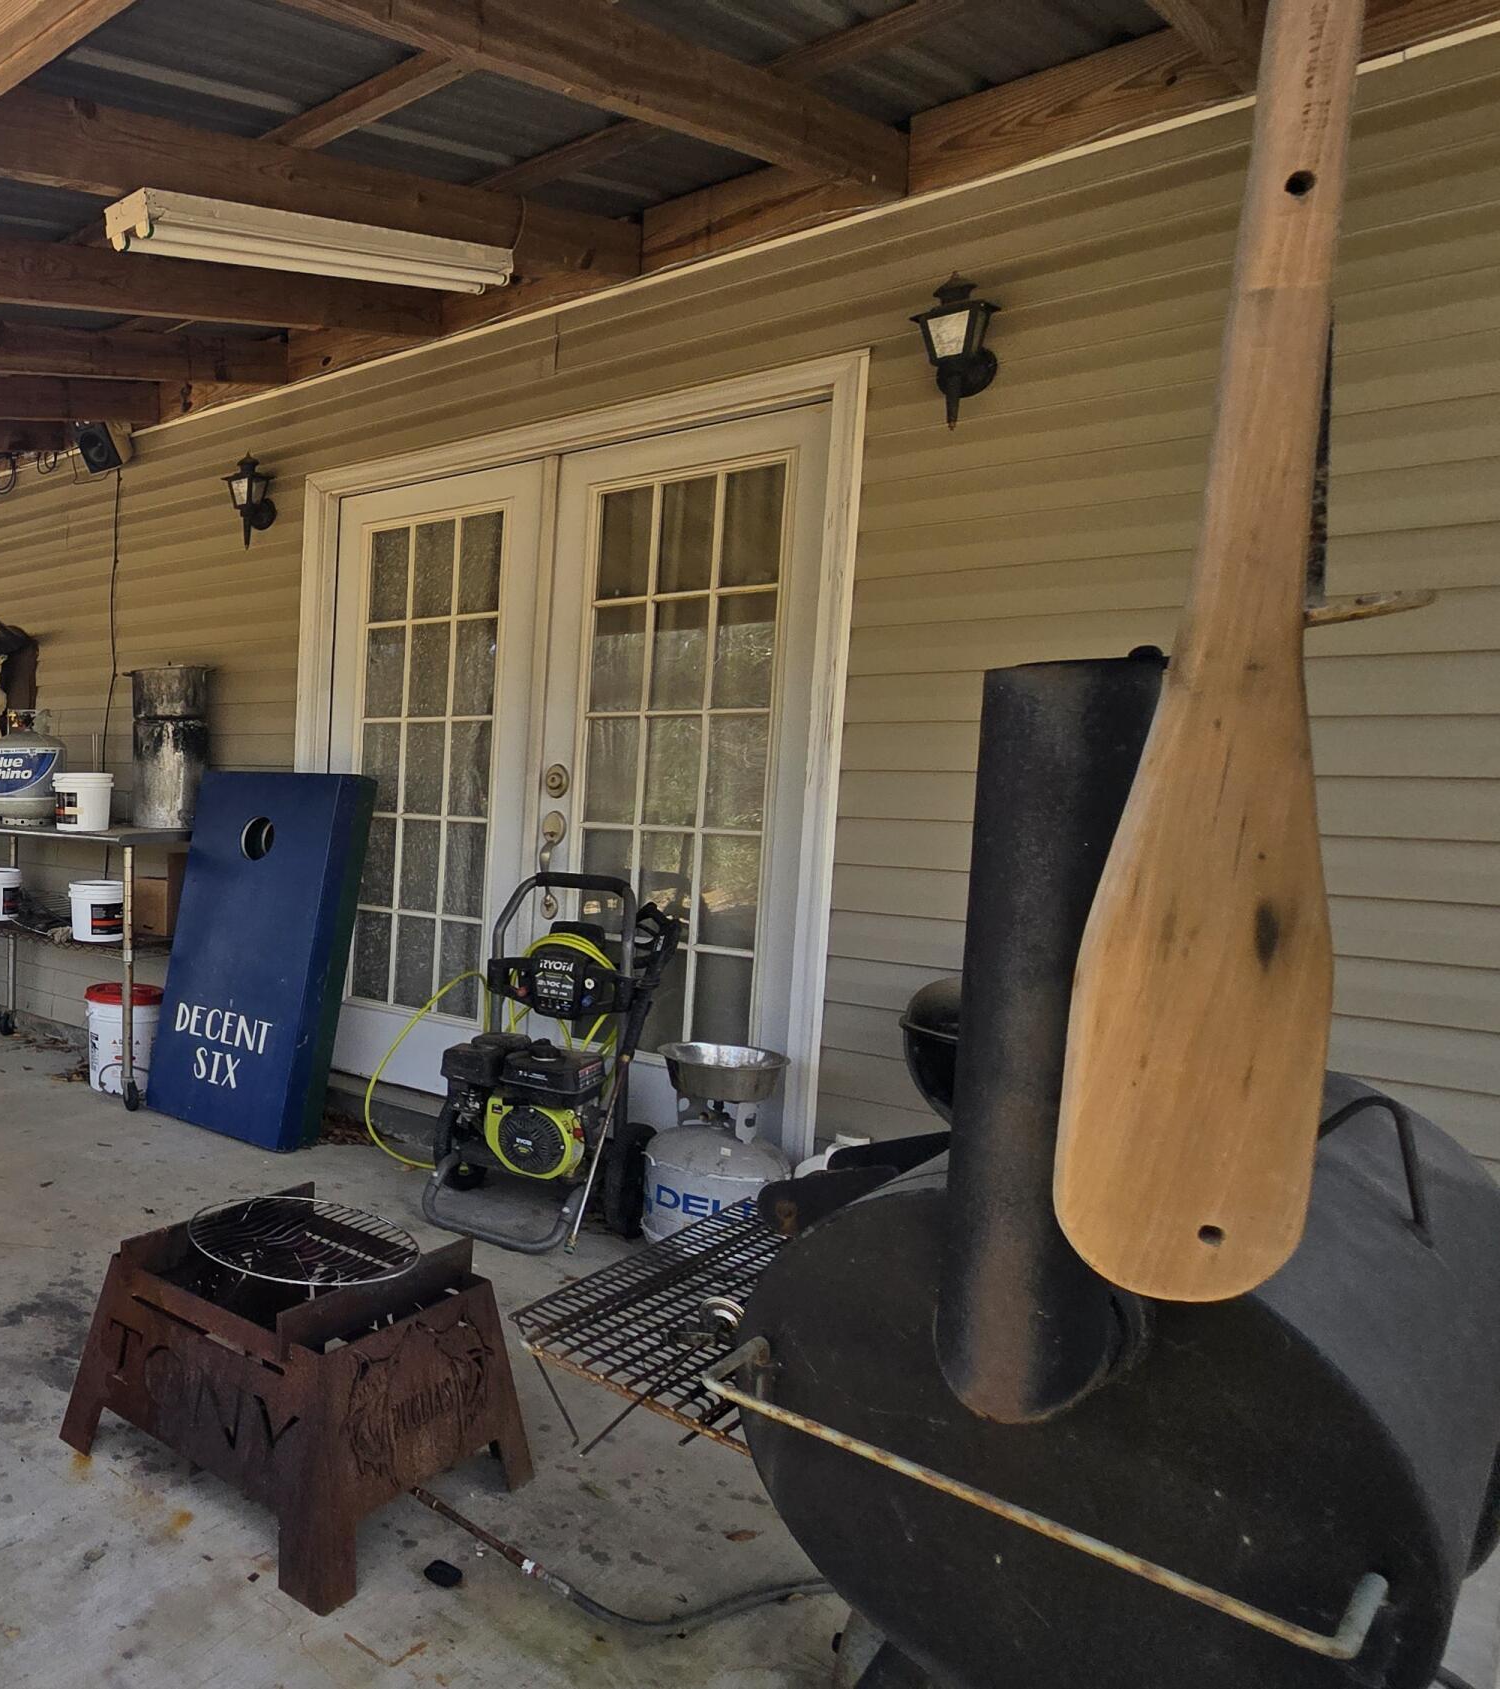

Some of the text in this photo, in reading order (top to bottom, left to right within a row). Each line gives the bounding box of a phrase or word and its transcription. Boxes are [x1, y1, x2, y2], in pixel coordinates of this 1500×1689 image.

[539, 959, 574, 972] RYOBI
[175, 1002, 273, 1054] DECENT
[193, 1046, 241, 1089] SIX
[106, 1318, 300, 1452] TONY
